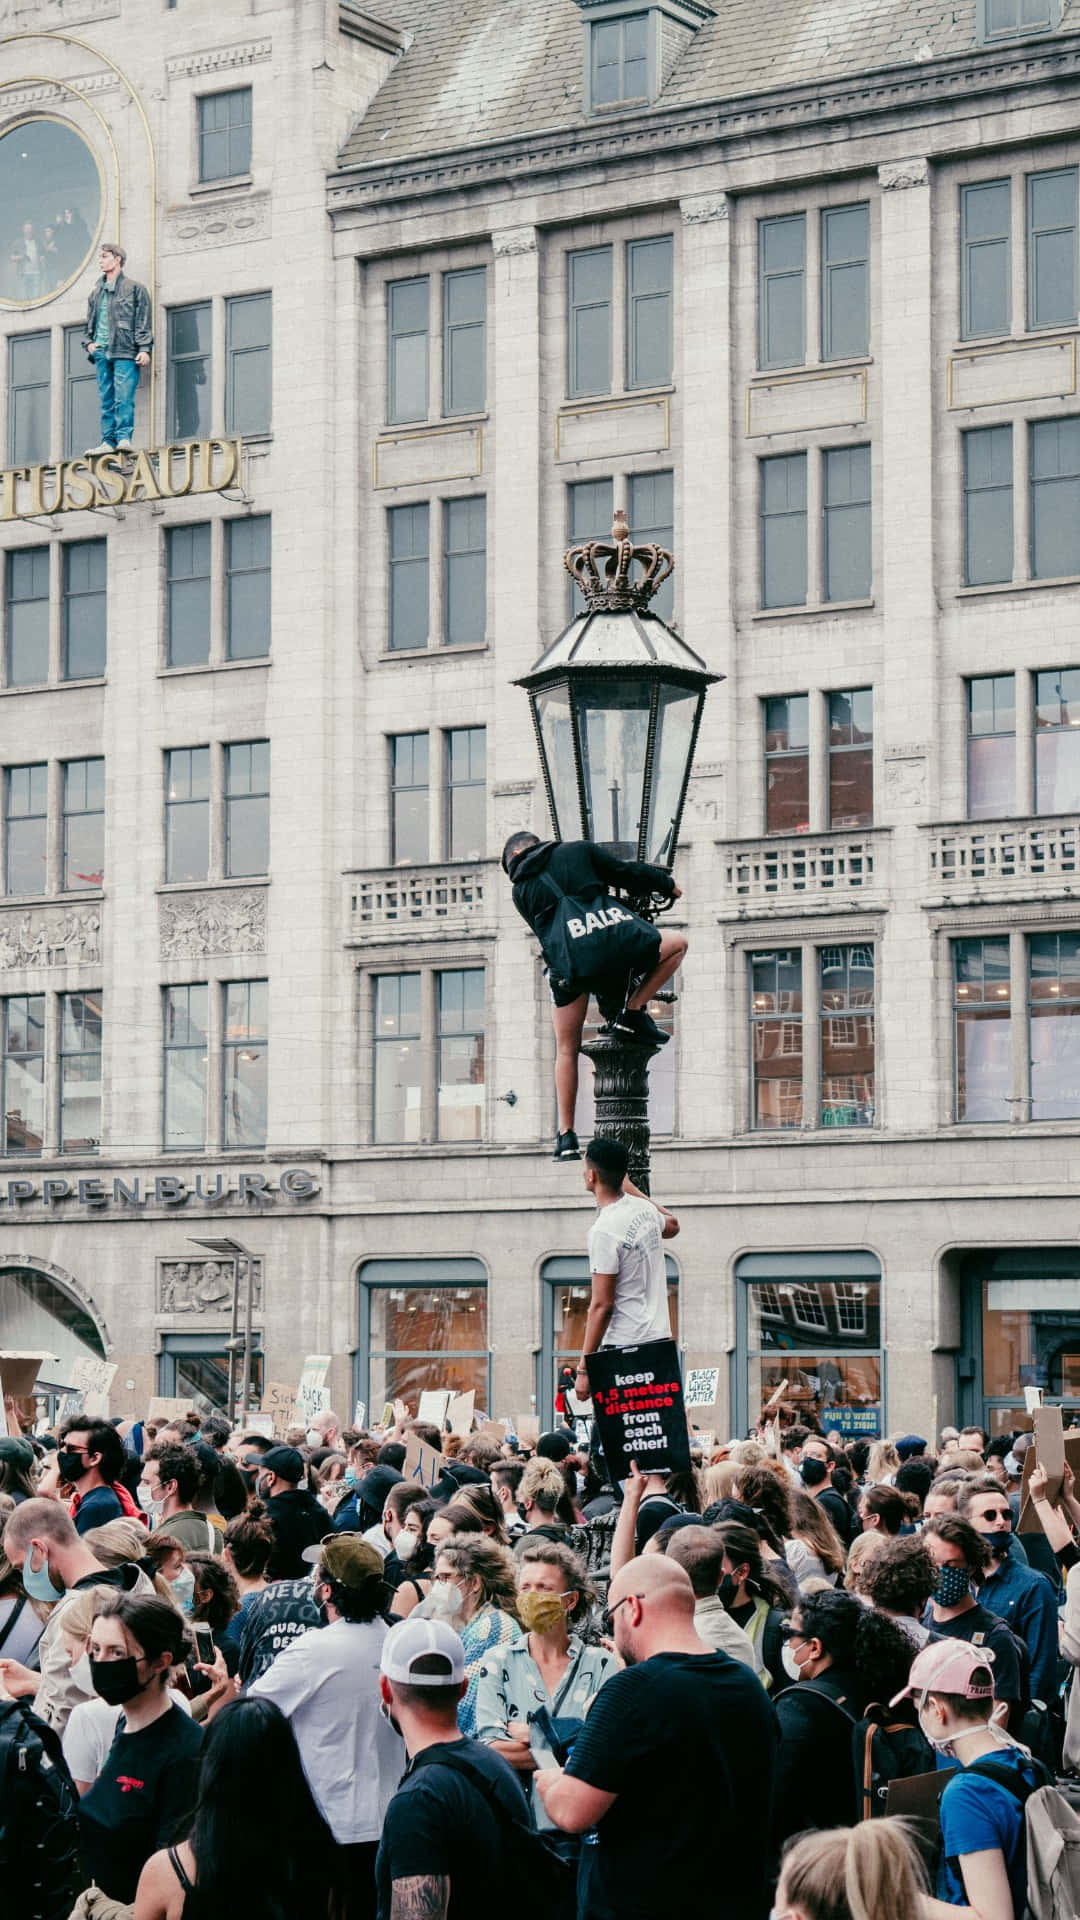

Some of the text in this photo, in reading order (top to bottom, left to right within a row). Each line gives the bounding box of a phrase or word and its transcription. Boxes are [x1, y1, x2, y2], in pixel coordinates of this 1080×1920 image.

[0, 439, 242, 520] TUSSAUD
[567, 907, 633, 939] BALR.
[7, 1168, 317, 1207] PPENBURG
[615, 1372, 655, 1386] keep
[691, 1370, 717, 1381] BLACK
[623, 1382, 680, 1398] meters
[688, 1380, 712, 1392] LIVES
[605, 1397, 673, 1415] distance
[622, 1412, 660, 1425] from
[624, 1423, 662, 1438] each
[622, 1436, 668, 1452] other!
[261, 1621, 316, 1637] OURA
